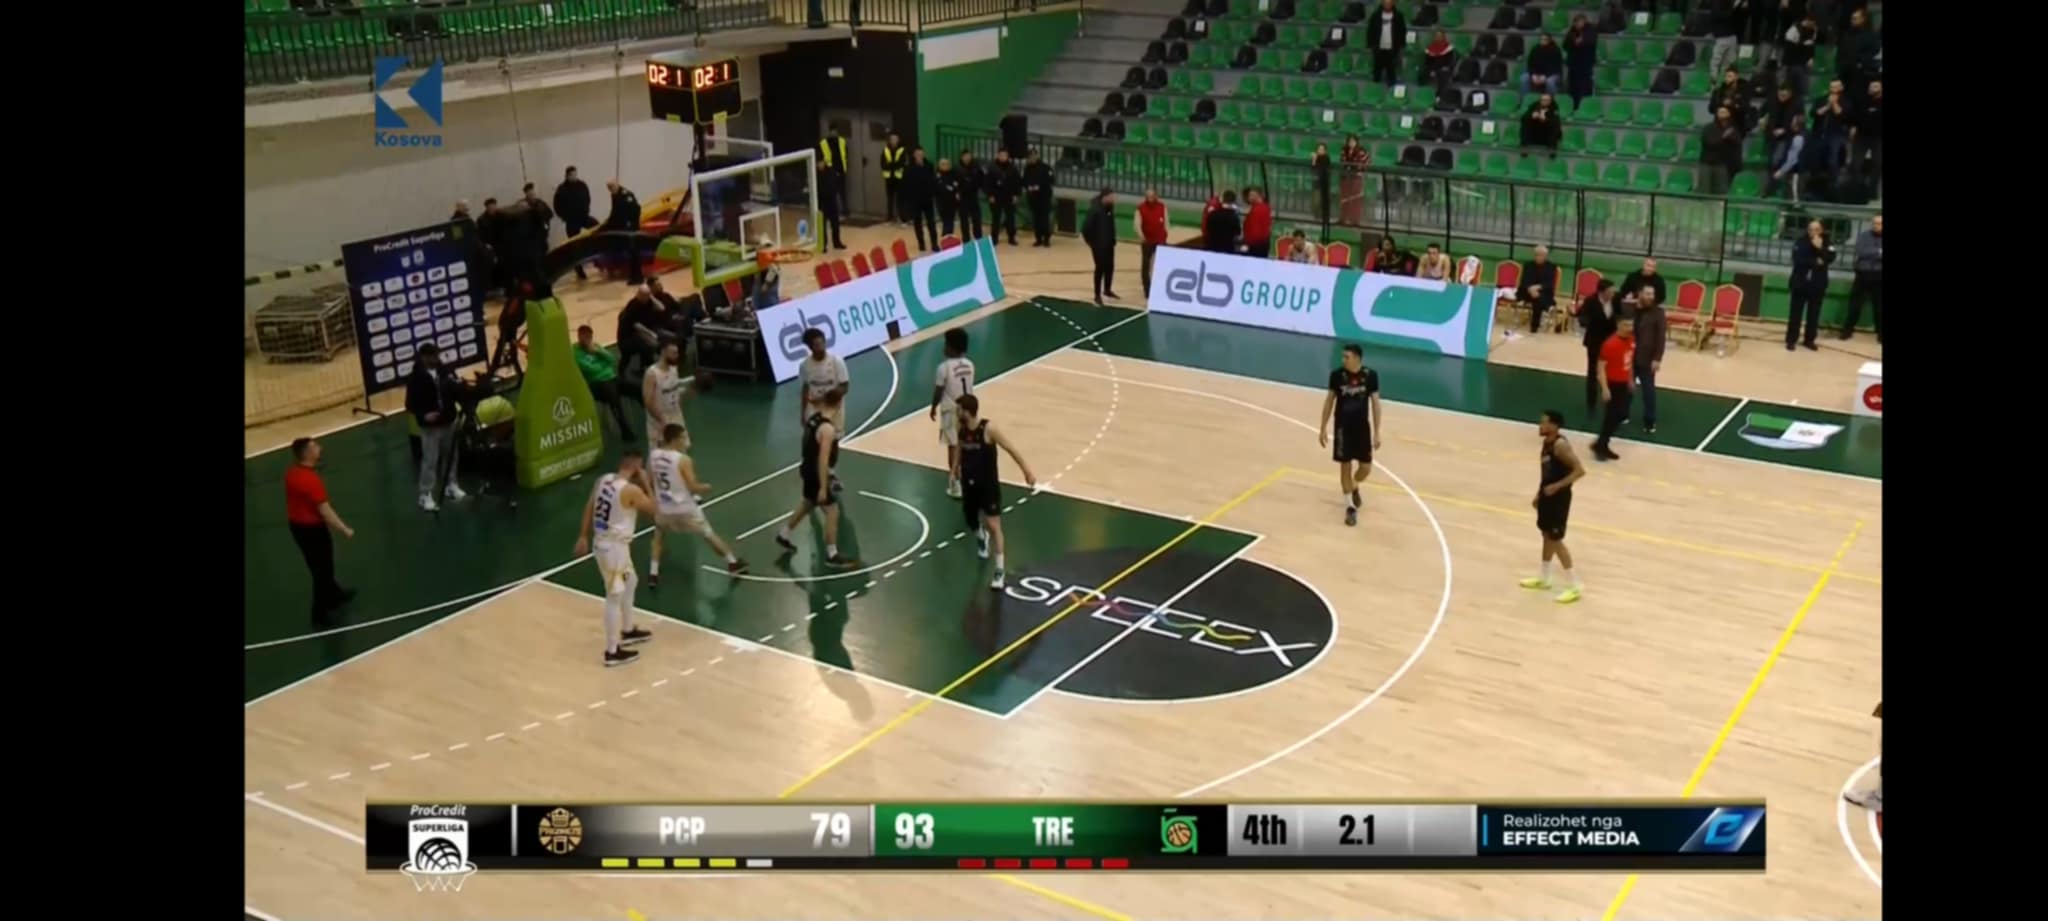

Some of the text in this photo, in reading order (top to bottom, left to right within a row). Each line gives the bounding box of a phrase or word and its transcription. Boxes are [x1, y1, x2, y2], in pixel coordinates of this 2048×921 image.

[1165, 260, 1321, 314] eb GROUP
[837, 293, 897, 335] GROUP
[540, 418, 593, 449] MISSINI
